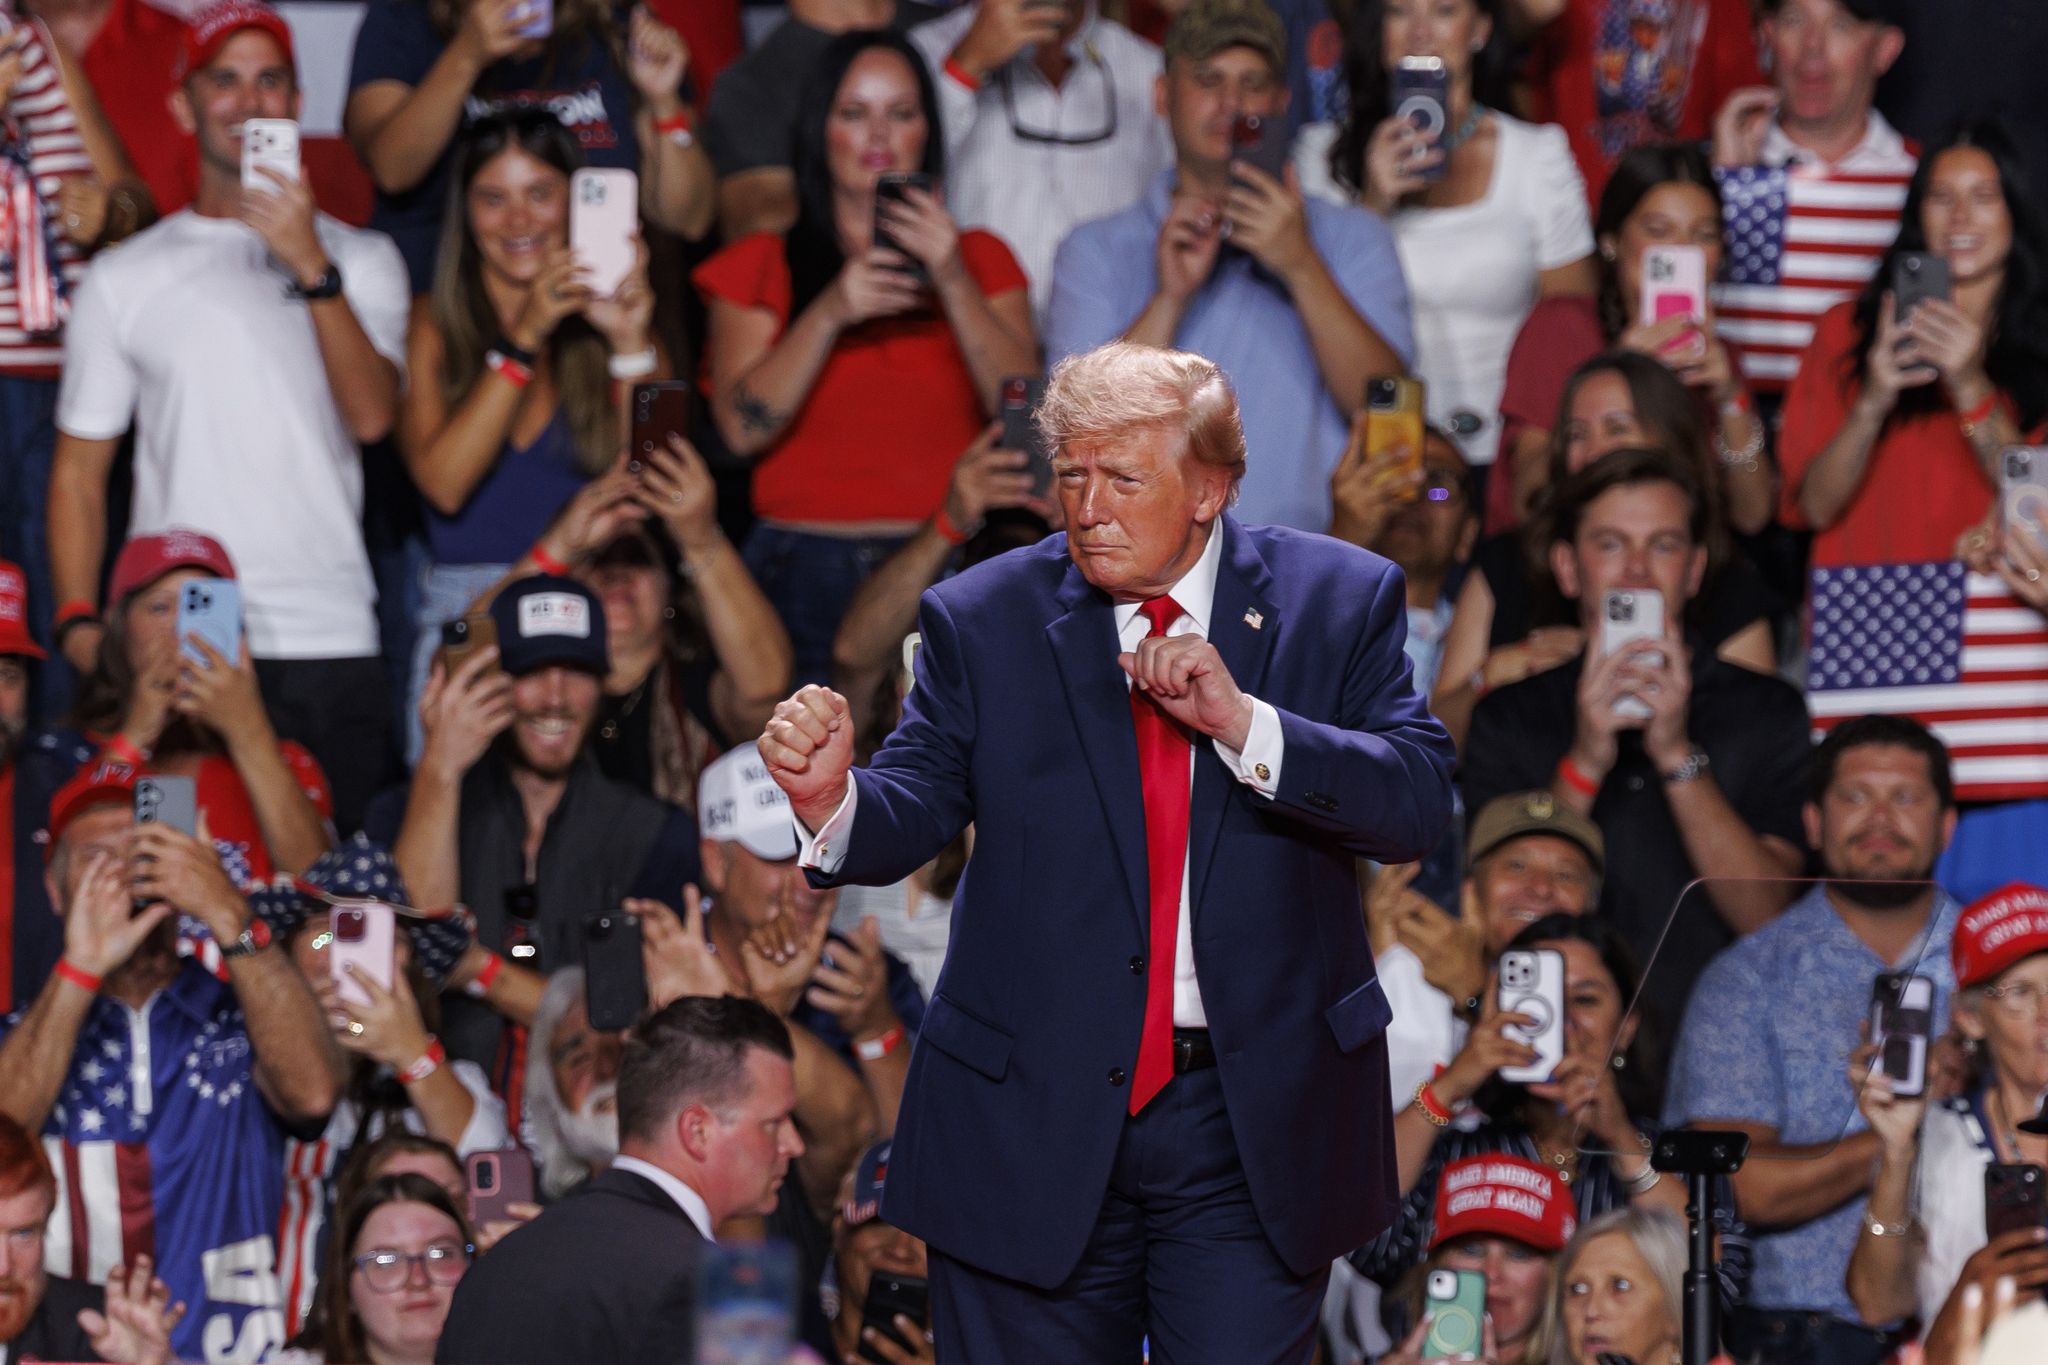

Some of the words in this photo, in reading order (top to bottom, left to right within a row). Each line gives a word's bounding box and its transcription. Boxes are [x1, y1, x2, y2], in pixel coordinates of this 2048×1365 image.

[1485, 1162, 1552, 1201] AMERICA
[1447, 1186, 1493, 1217] GREAT
[1494, 1189, 1545, 1221] AGAIN
